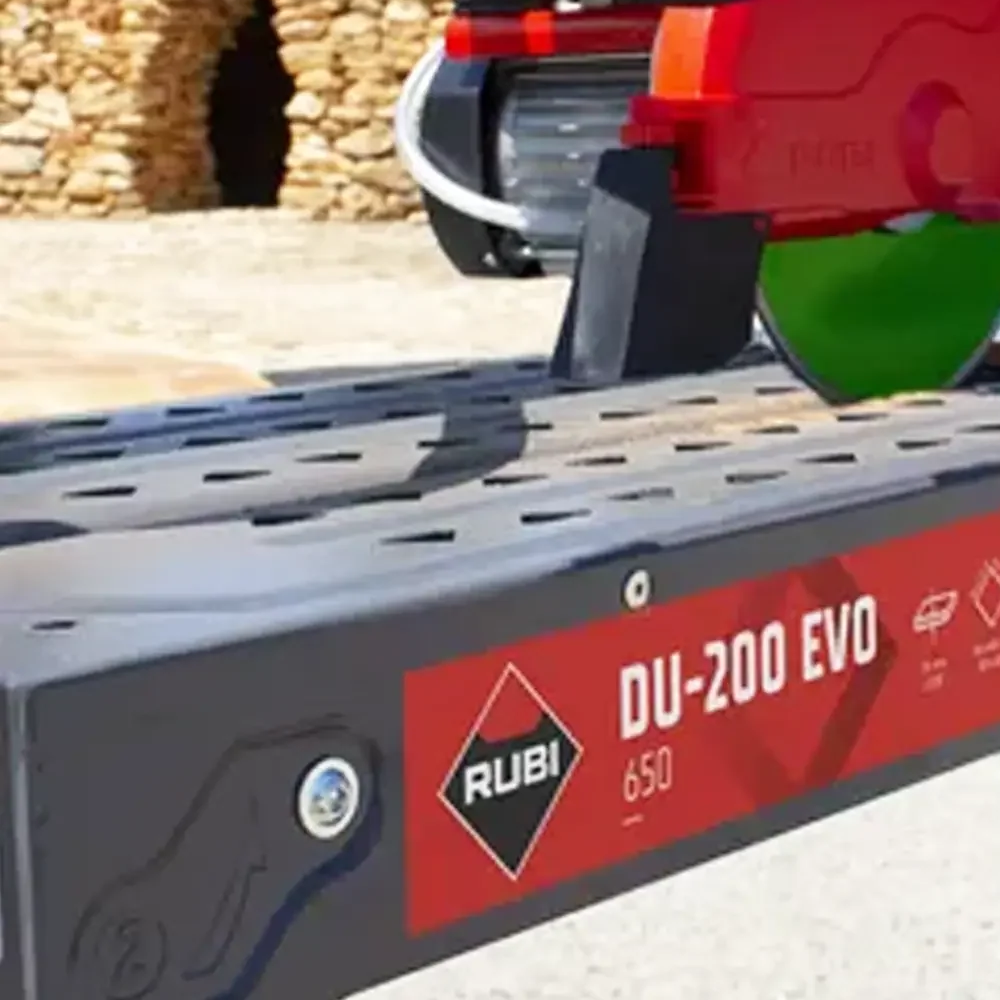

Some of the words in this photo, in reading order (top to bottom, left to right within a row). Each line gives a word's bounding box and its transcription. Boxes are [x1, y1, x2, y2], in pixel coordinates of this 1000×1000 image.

[619, 621, 786, 740] DU-200
[801, 594, 877, 682] EVO
[464, 739, 561, 805] RUBI
[624, 745, 672, 803] 650
